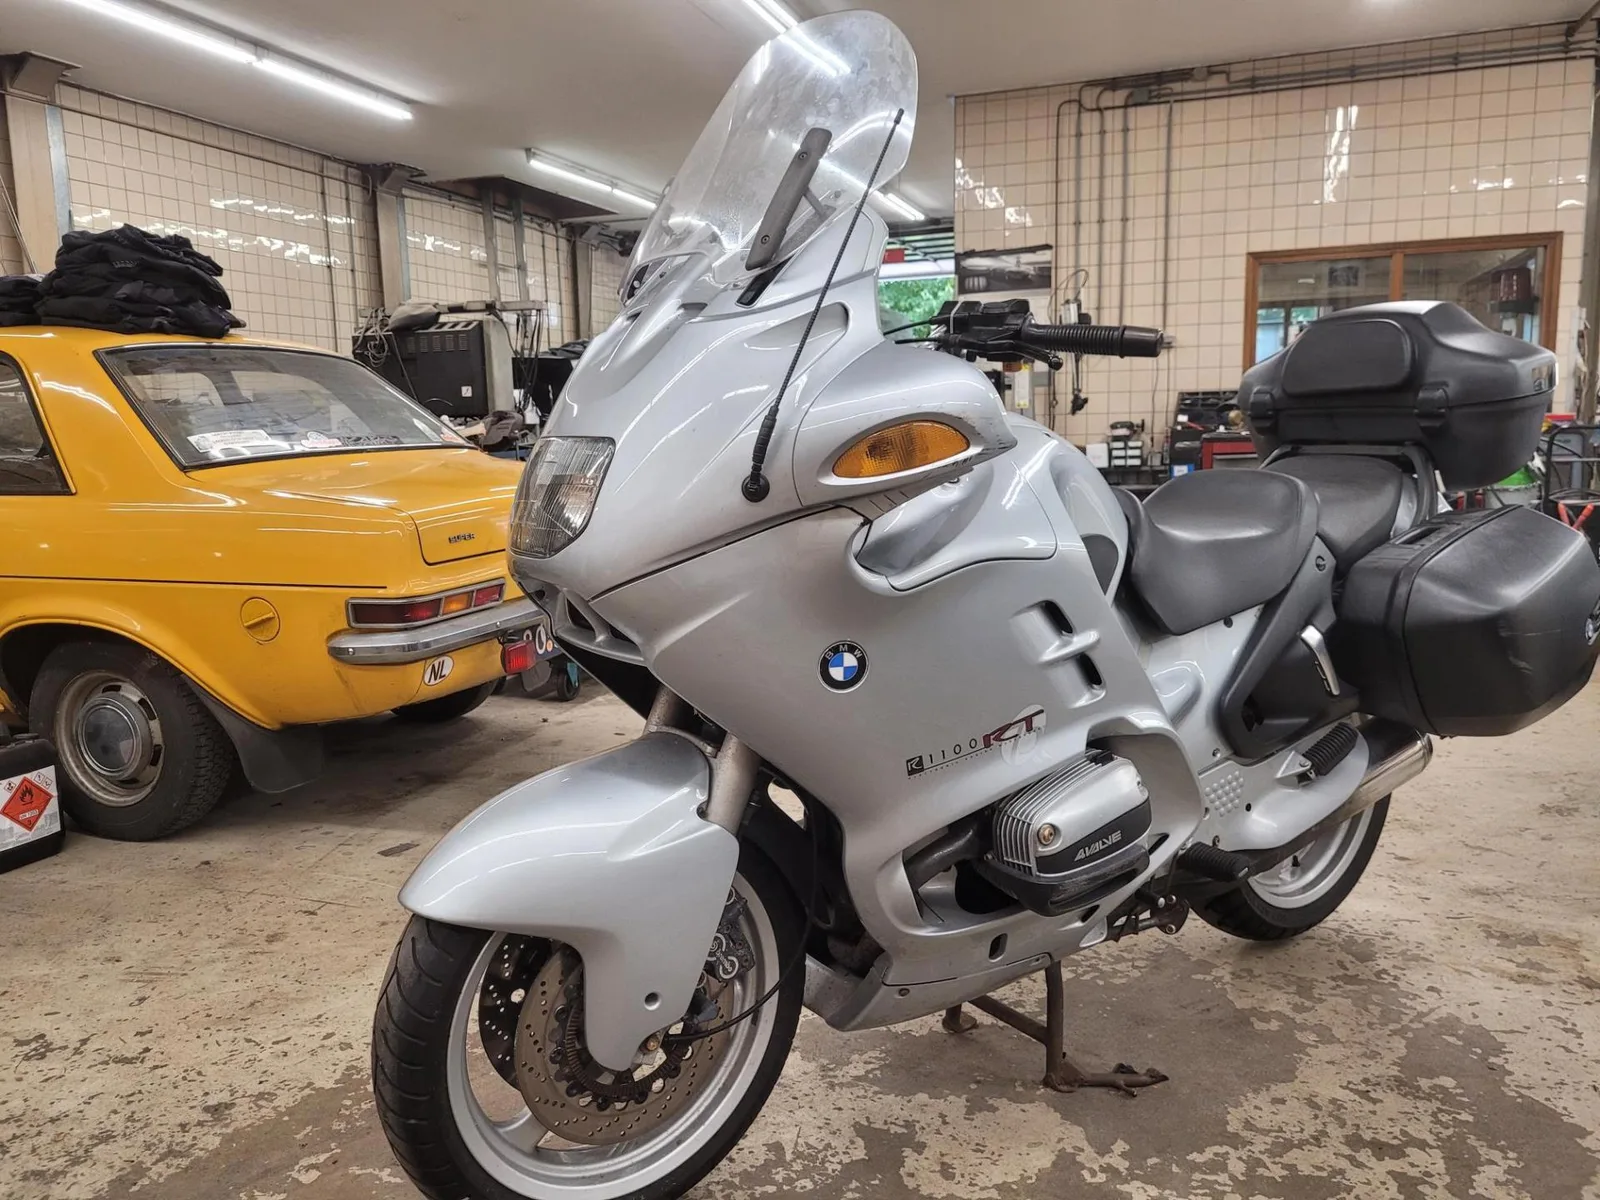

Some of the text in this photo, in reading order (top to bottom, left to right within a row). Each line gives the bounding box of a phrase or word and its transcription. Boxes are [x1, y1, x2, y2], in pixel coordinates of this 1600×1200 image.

[448, 532, 476, 544] SUPER
[824, 644, 863, 660] BMW
[427, 659, 446, 684] NL
